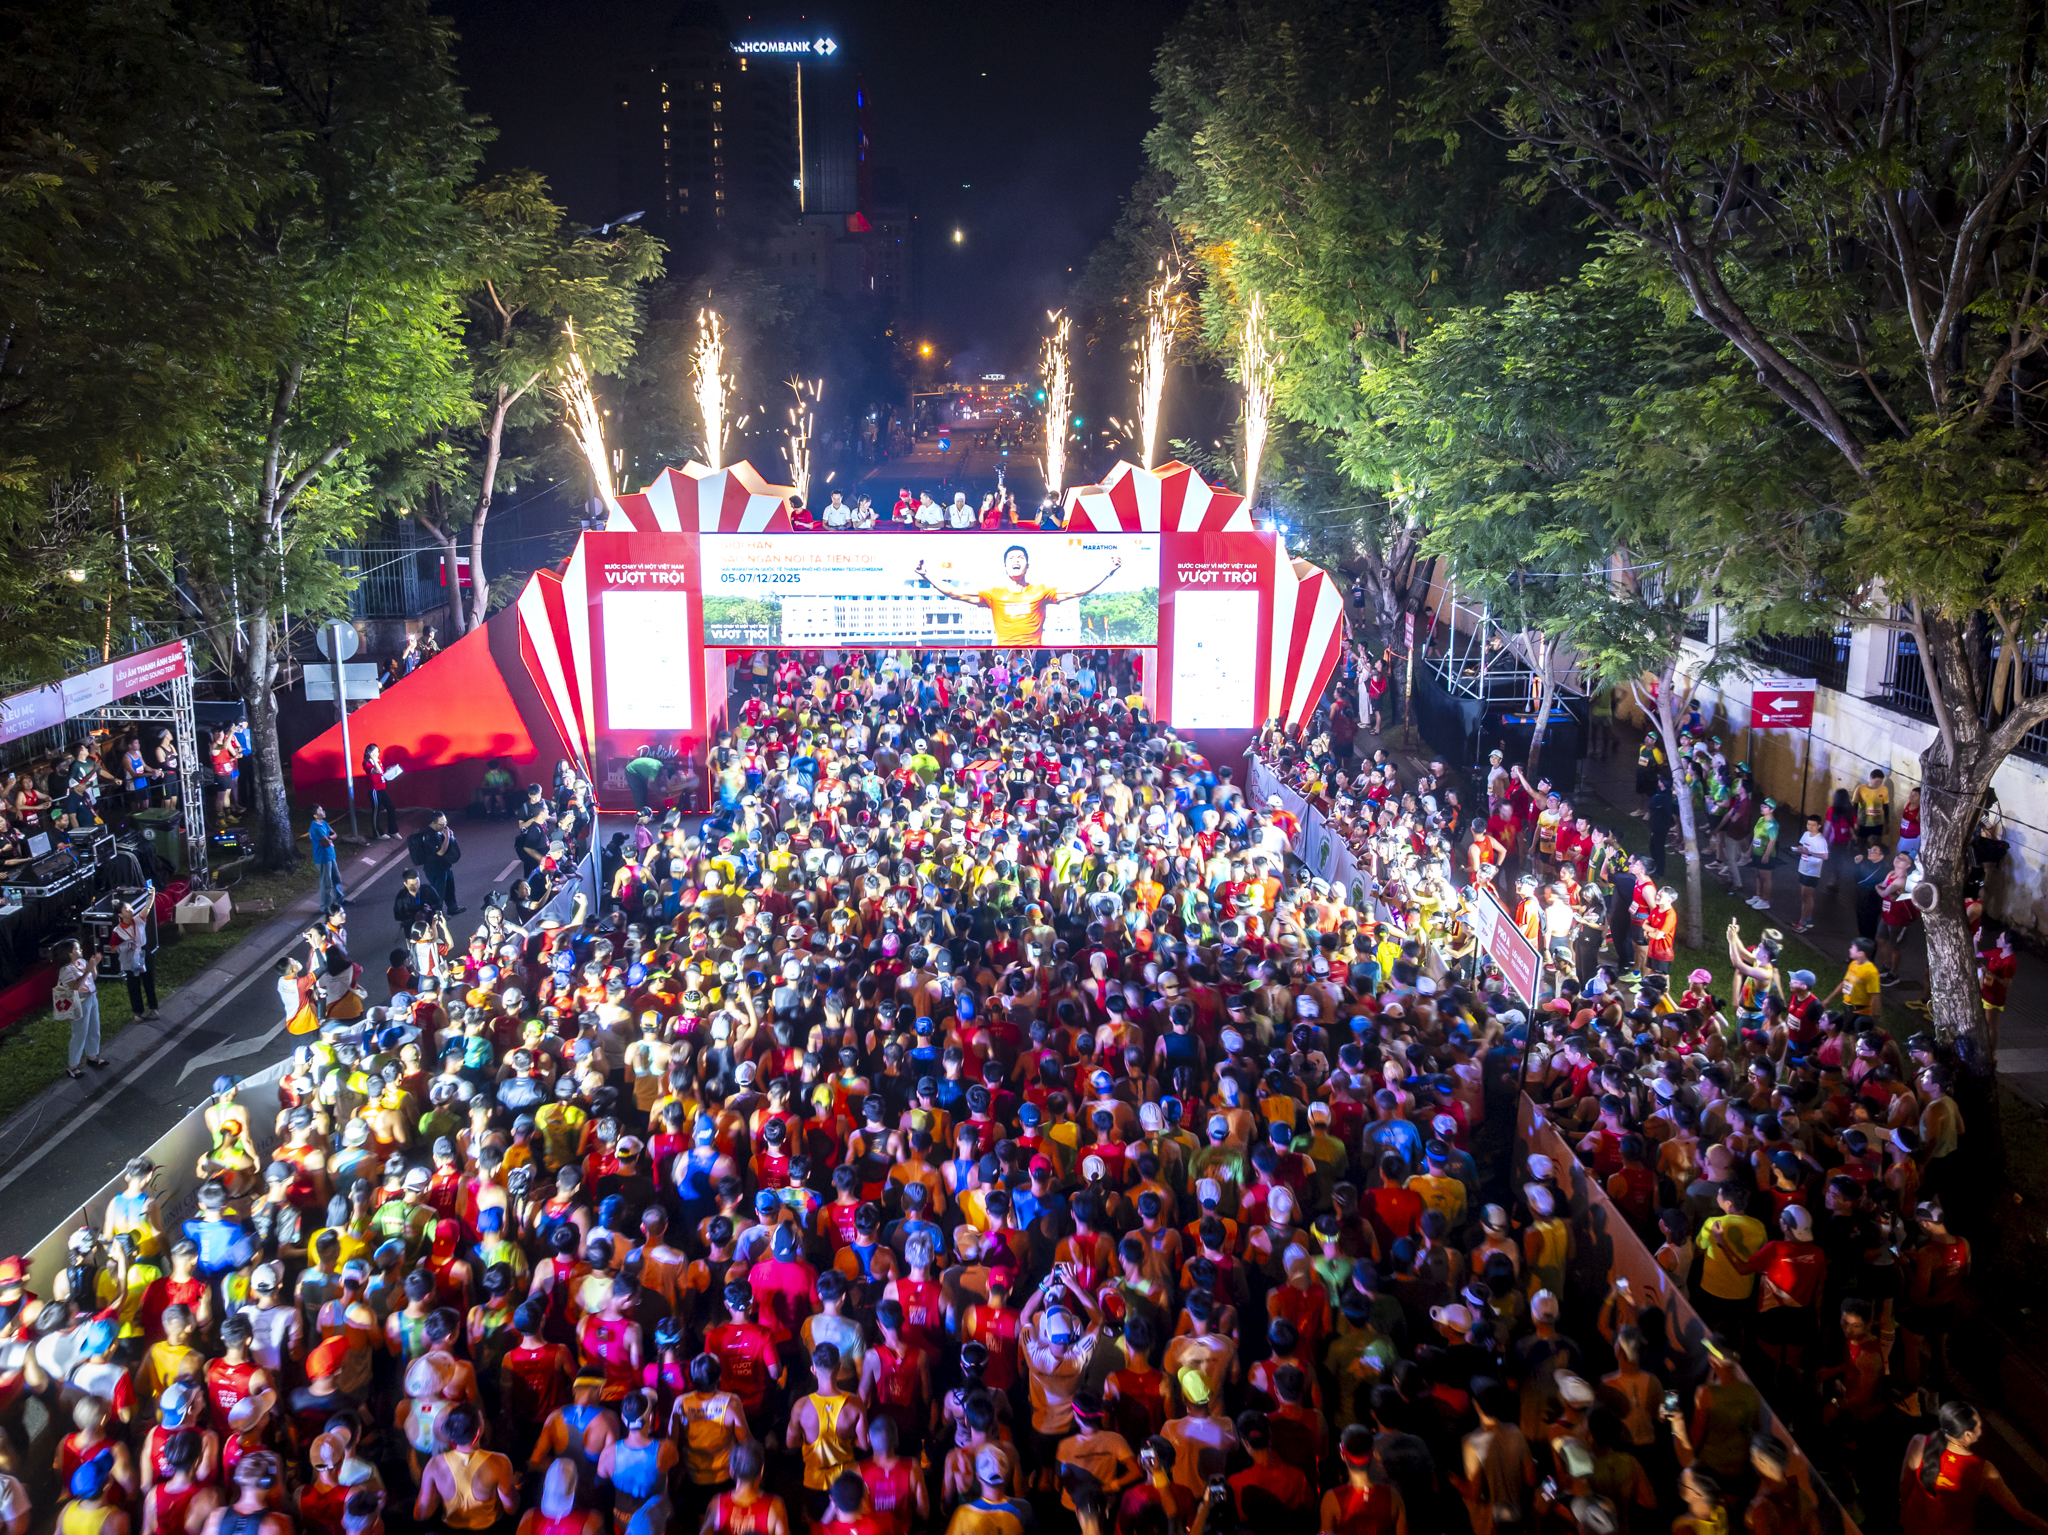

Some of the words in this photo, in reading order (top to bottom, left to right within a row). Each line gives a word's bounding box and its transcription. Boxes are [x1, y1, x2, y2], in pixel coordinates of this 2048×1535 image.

[809, 555, 822, 563] TA
[605, 570, 646, 585] VƯỢT
[650, 570, 684, 585] TRỘI
[720, 574, 801, 583] 05-07/12/2025
[1177, 569, 1219, 585] VƯỢT
[1222, 569, 1257, 585] TRỘI
[711, 629, 741, 639] VƯỢT
[137, 661, 156, 674] THANH
[168, 652, 182, 663] SÁNG
[125, 678, 138, 688] LIGHT
[139, 674, 148, 682] AND
[149, 669, 165, 680] SOUND
[165, 664, 176, 673] TENT
[21, 704, 34, 716] MC
[6, 724, 17, 735] MC
[18, 717, 35, 730] TENT
[1498, 924, 1507, 942] PRO
[1506, 936, 1510, 948] A
